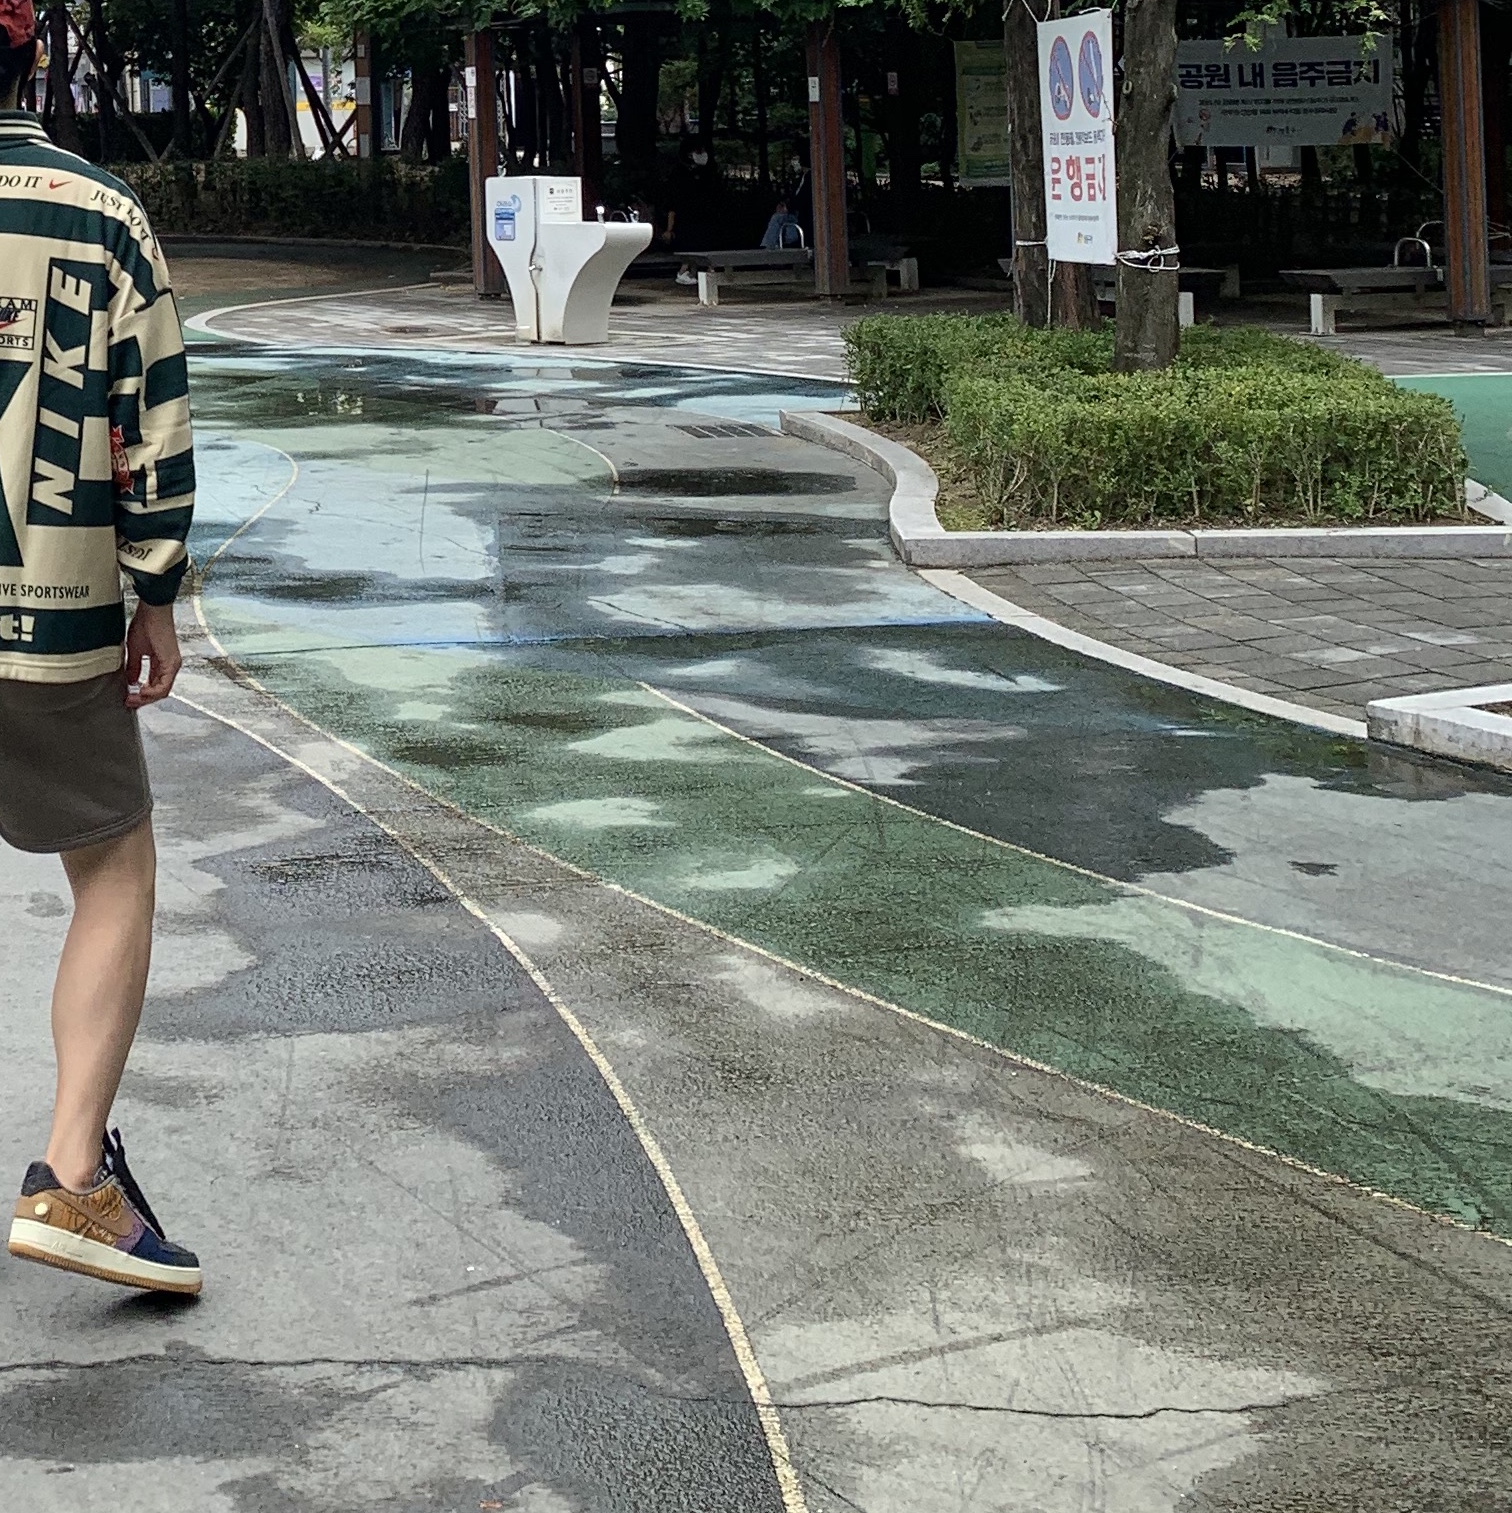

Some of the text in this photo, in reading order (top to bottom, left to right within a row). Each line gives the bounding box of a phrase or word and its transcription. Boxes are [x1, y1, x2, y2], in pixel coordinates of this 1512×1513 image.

[1178, 59, 1380, 89] 공원 내 음주금지
[24, 176, 43, 189] IT
[1051, 154, 1106, 202] 운행금지
[90, 190, 125, 210] JUST
[32, 265, 92, 515] NIKE
[20, 585, 90, 600] SPORTSWEAR
